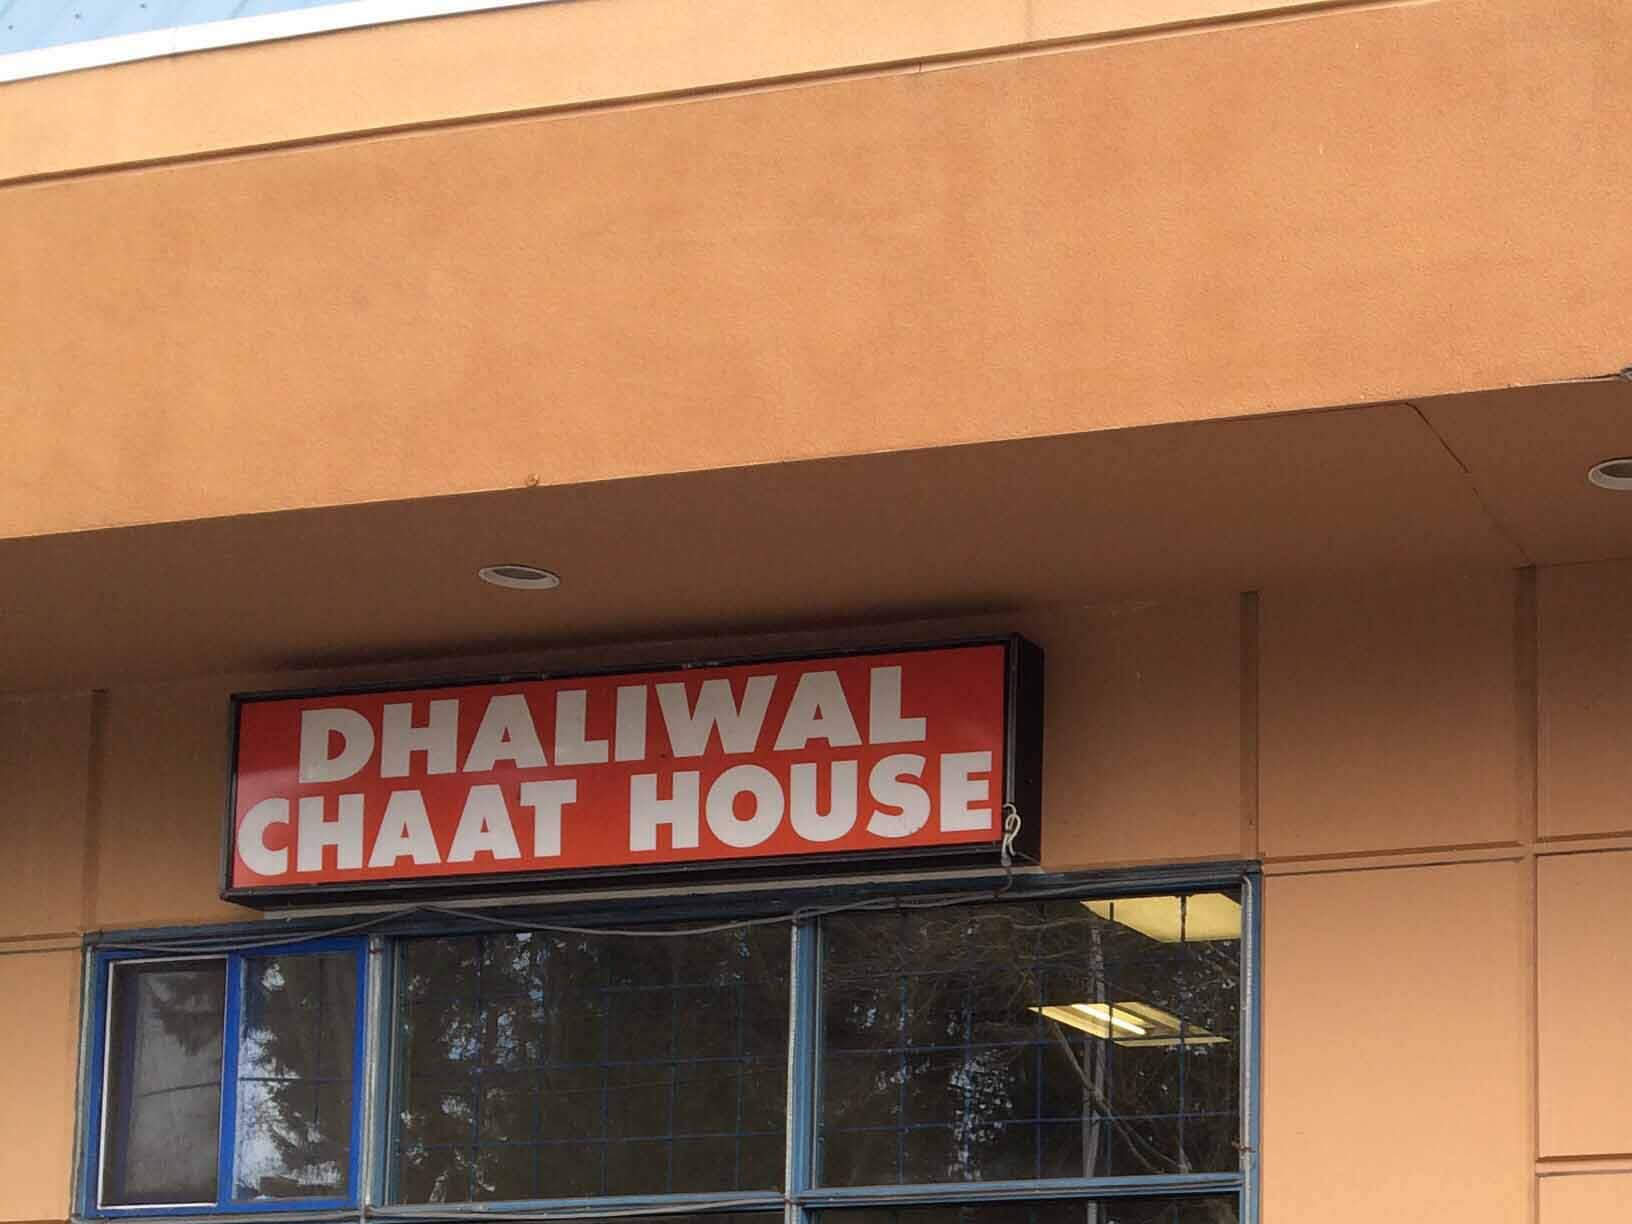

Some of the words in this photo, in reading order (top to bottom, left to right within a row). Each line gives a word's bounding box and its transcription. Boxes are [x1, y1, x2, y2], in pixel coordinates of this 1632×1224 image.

[298, 665, 926, 784] DHALIWAL
[236, 780, 577, 877] CHAAT
[629, 752, 993, 850] HOUSE
